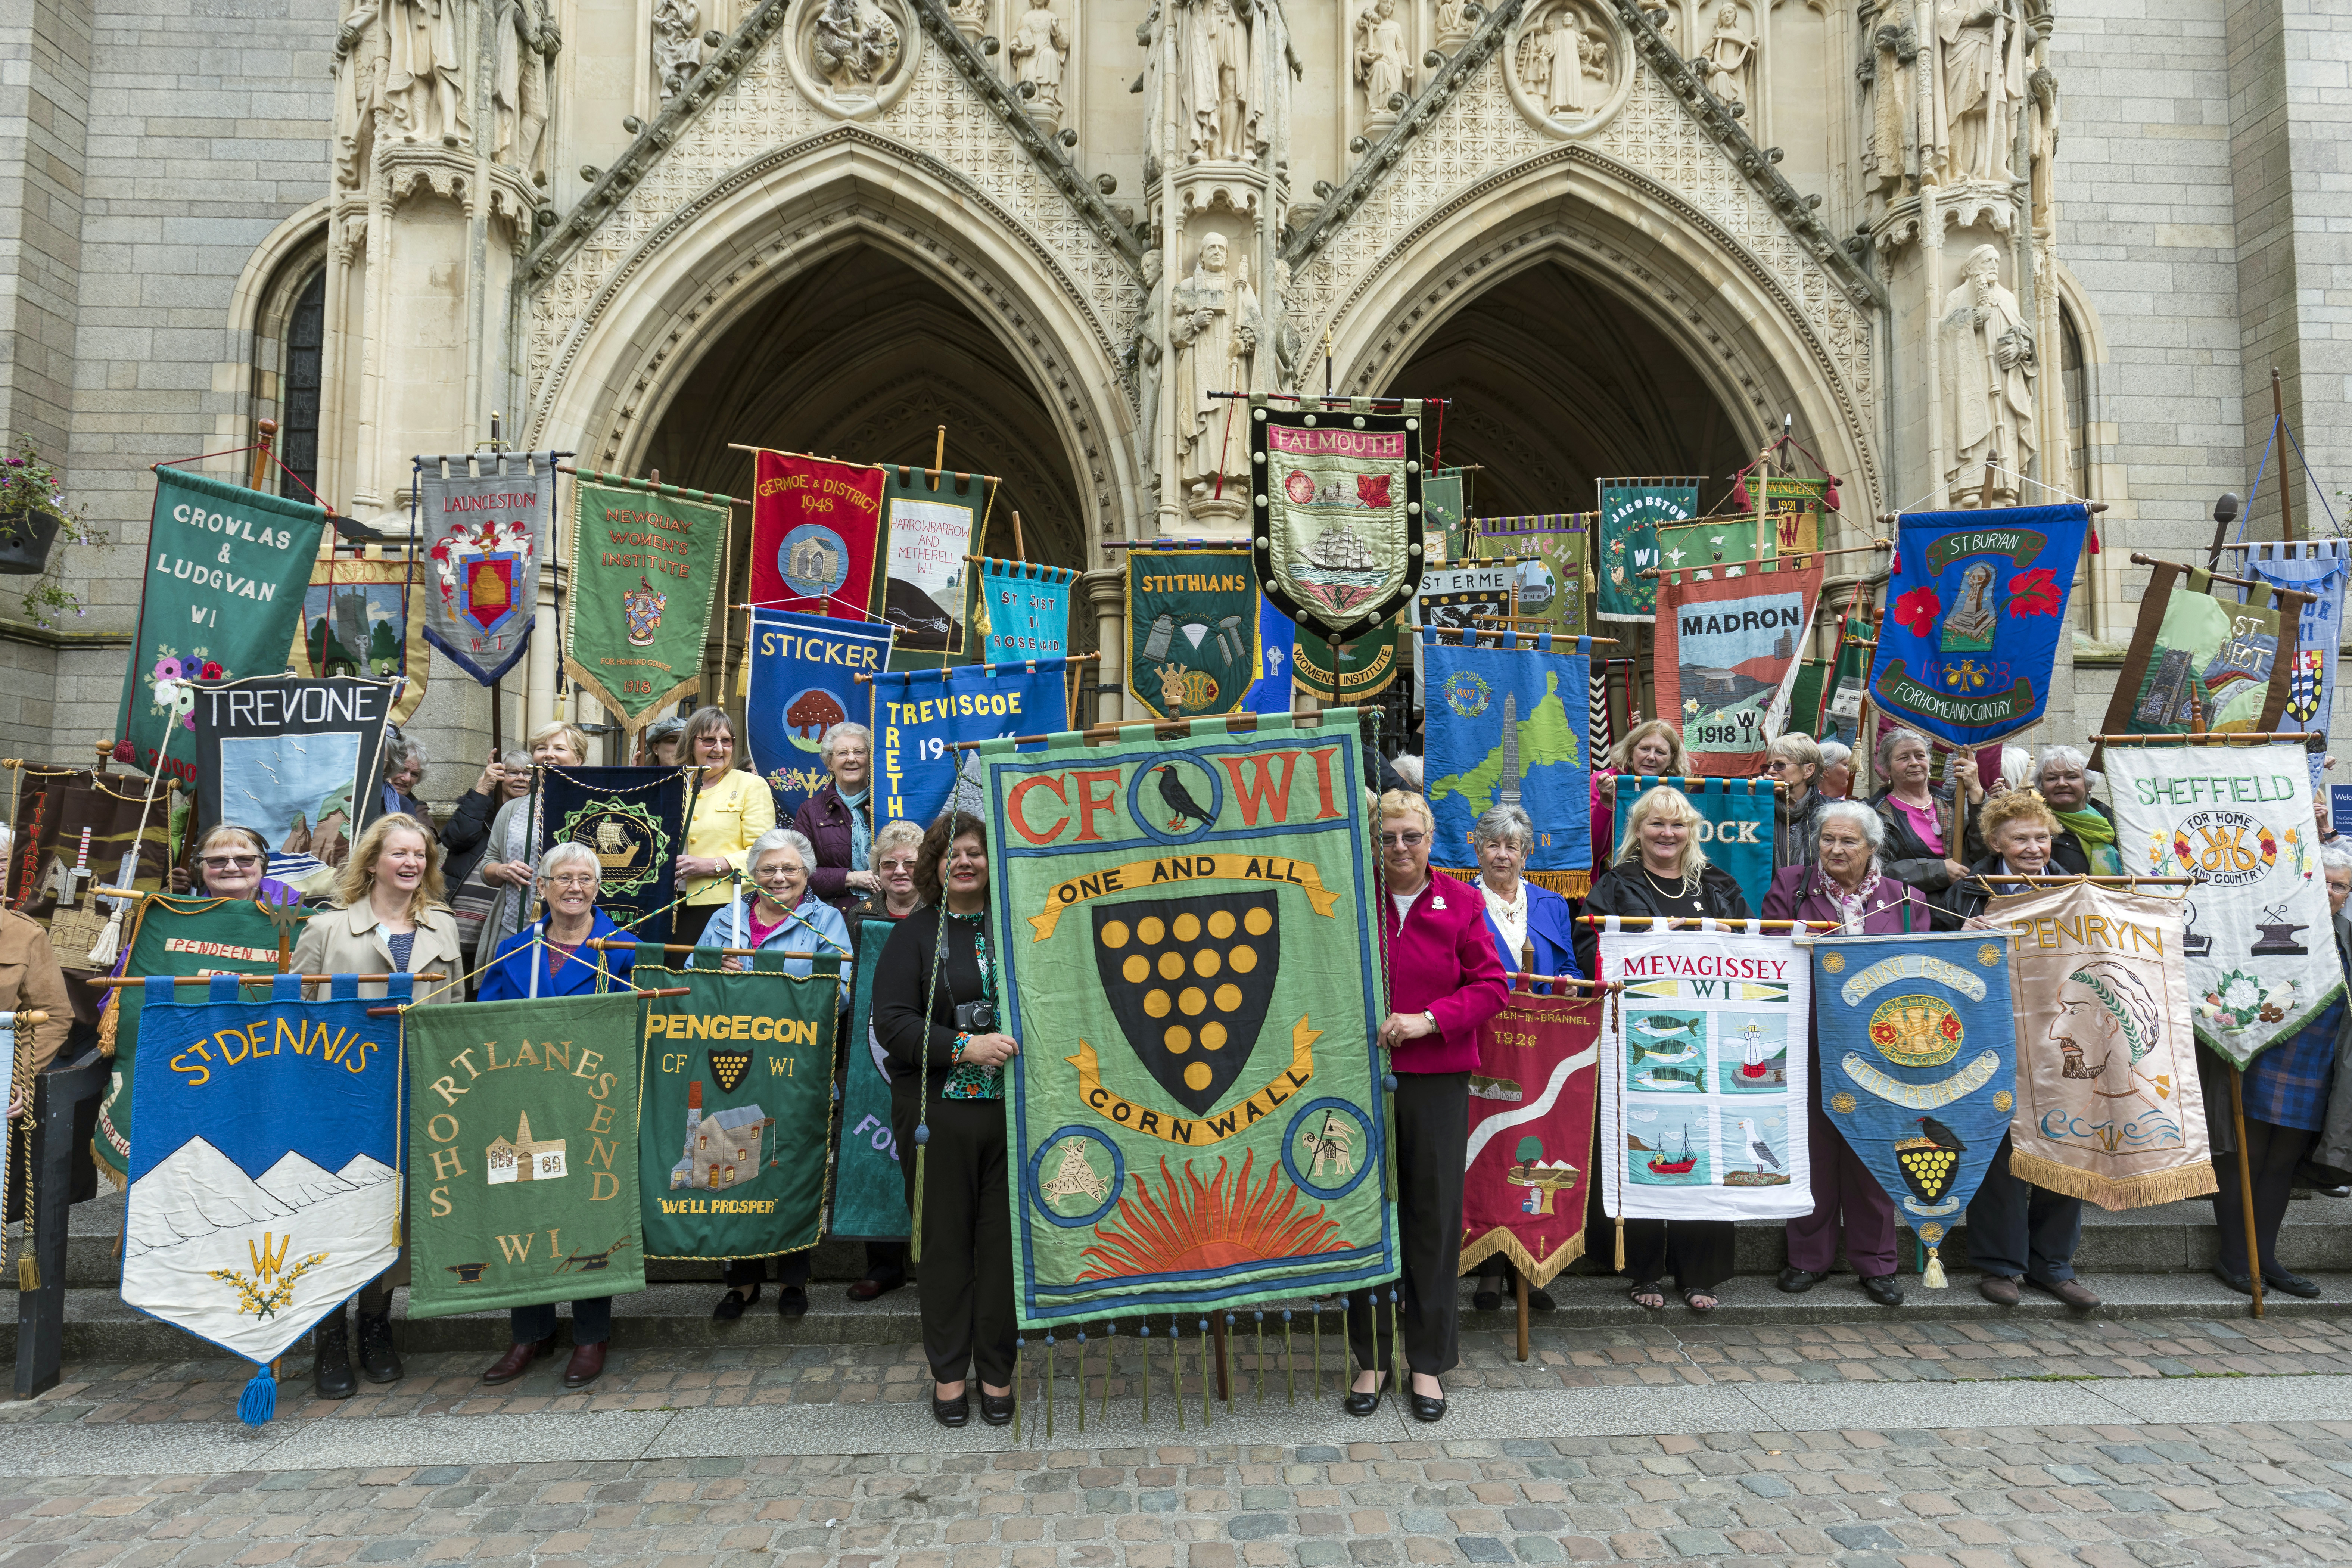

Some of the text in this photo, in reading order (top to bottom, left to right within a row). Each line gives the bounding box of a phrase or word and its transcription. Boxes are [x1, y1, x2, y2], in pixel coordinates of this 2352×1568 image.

[1278, 430, 1396, 453] FALMOUTH
[759, 475, 879, 515] GERMOE & DISTRICT
[1750, 481, 1822, 495] DWNDERRY
[443, 493, 536, 513] LAUNCESTON
[801, 494, 834, 514] 1948
[1611, 497, 1688, 523] JACOBSTOW
[1778, 500, 1796, 511] 1921
[173, 504, 291, 549] CROWLAS
[607, 508, 693, 535] NEWQUAY
[891, 517, 970, 539] HARROWBARROW
[609, 530, 688, 556] WOMEN'S
[918, 534, 940, 548] AND
[1972, 533, 2019, 550] BURYAN
[218, 543, 230, 564] &
[602, 552, 690, 578] INSTITUTE
[899, 547, 956, 565] METHERELL
[1634, 548, 1658, 567] WI
[156, 554, 277, 601] LUDGVAN
[1142, 574, 1246, 593] STITHIANS
[1453, 573, 1504, 589] ERME
[1001, 591, 1055, 610] ST JUST
[192, 606, 217, 628] WI
[1178, 613, 1191, 622] 1937
[1682, 607, 1799, 636] MADRON
[760, 632, 880, 670] STICKER
[994, 635, 1059, 651] ROSELAND
[647, 659, 672, 672] COUNTRY
[1293, 648, 1334, 685] WOMENS
[1344, 648, 1390, 685] INSTITUTE
[2216, 638, 2272, 672] NEOT
[623, 680, 651, 693] 1918
[203, 686, 378, 727] TREVONE
[887, 691, 1021, 725] TREVISCOE
[1698, 725, 1736, 743] 1918
[148, 748, 196, 783] 2000
[1007, 747, 1342, 845] CF WI
[2135, 775, 2294, 805] SHEFFIELD
[2187, 813, 2252, 829] FOR HOME
[1058, 856, 1303, 903] ONE AND ALL
[2215, 865, 2264, 884] COUNTRY
[2011, 914, 2163, 957] PENRYN
[1623, 956, 1789, 980] MEVAGISSEY
[1849, 956, 1979, 998] SAINT ISSEY
[1691, 979, 1732, 1001] WI
[1878, 998, 1951, 1021] FOR HOME
[648, 1014, 818, 1045] PENGEGON
[1495, 1031, 1537, 1048] 1926
[214, 1017, 378, 1073] DENNIS
[1885, 1043, 1958, 1065] AND COUNTRY
[663, 1054, 794, 1076] CF WI
[1844, 1057, 1997, 1109] LITTLE PETHERICK
[1090, 1069, 1309, 1144] CORNWALL
[102, 1115, 115, 1142] FOR
[495, 1228, 562, 1264] WI
